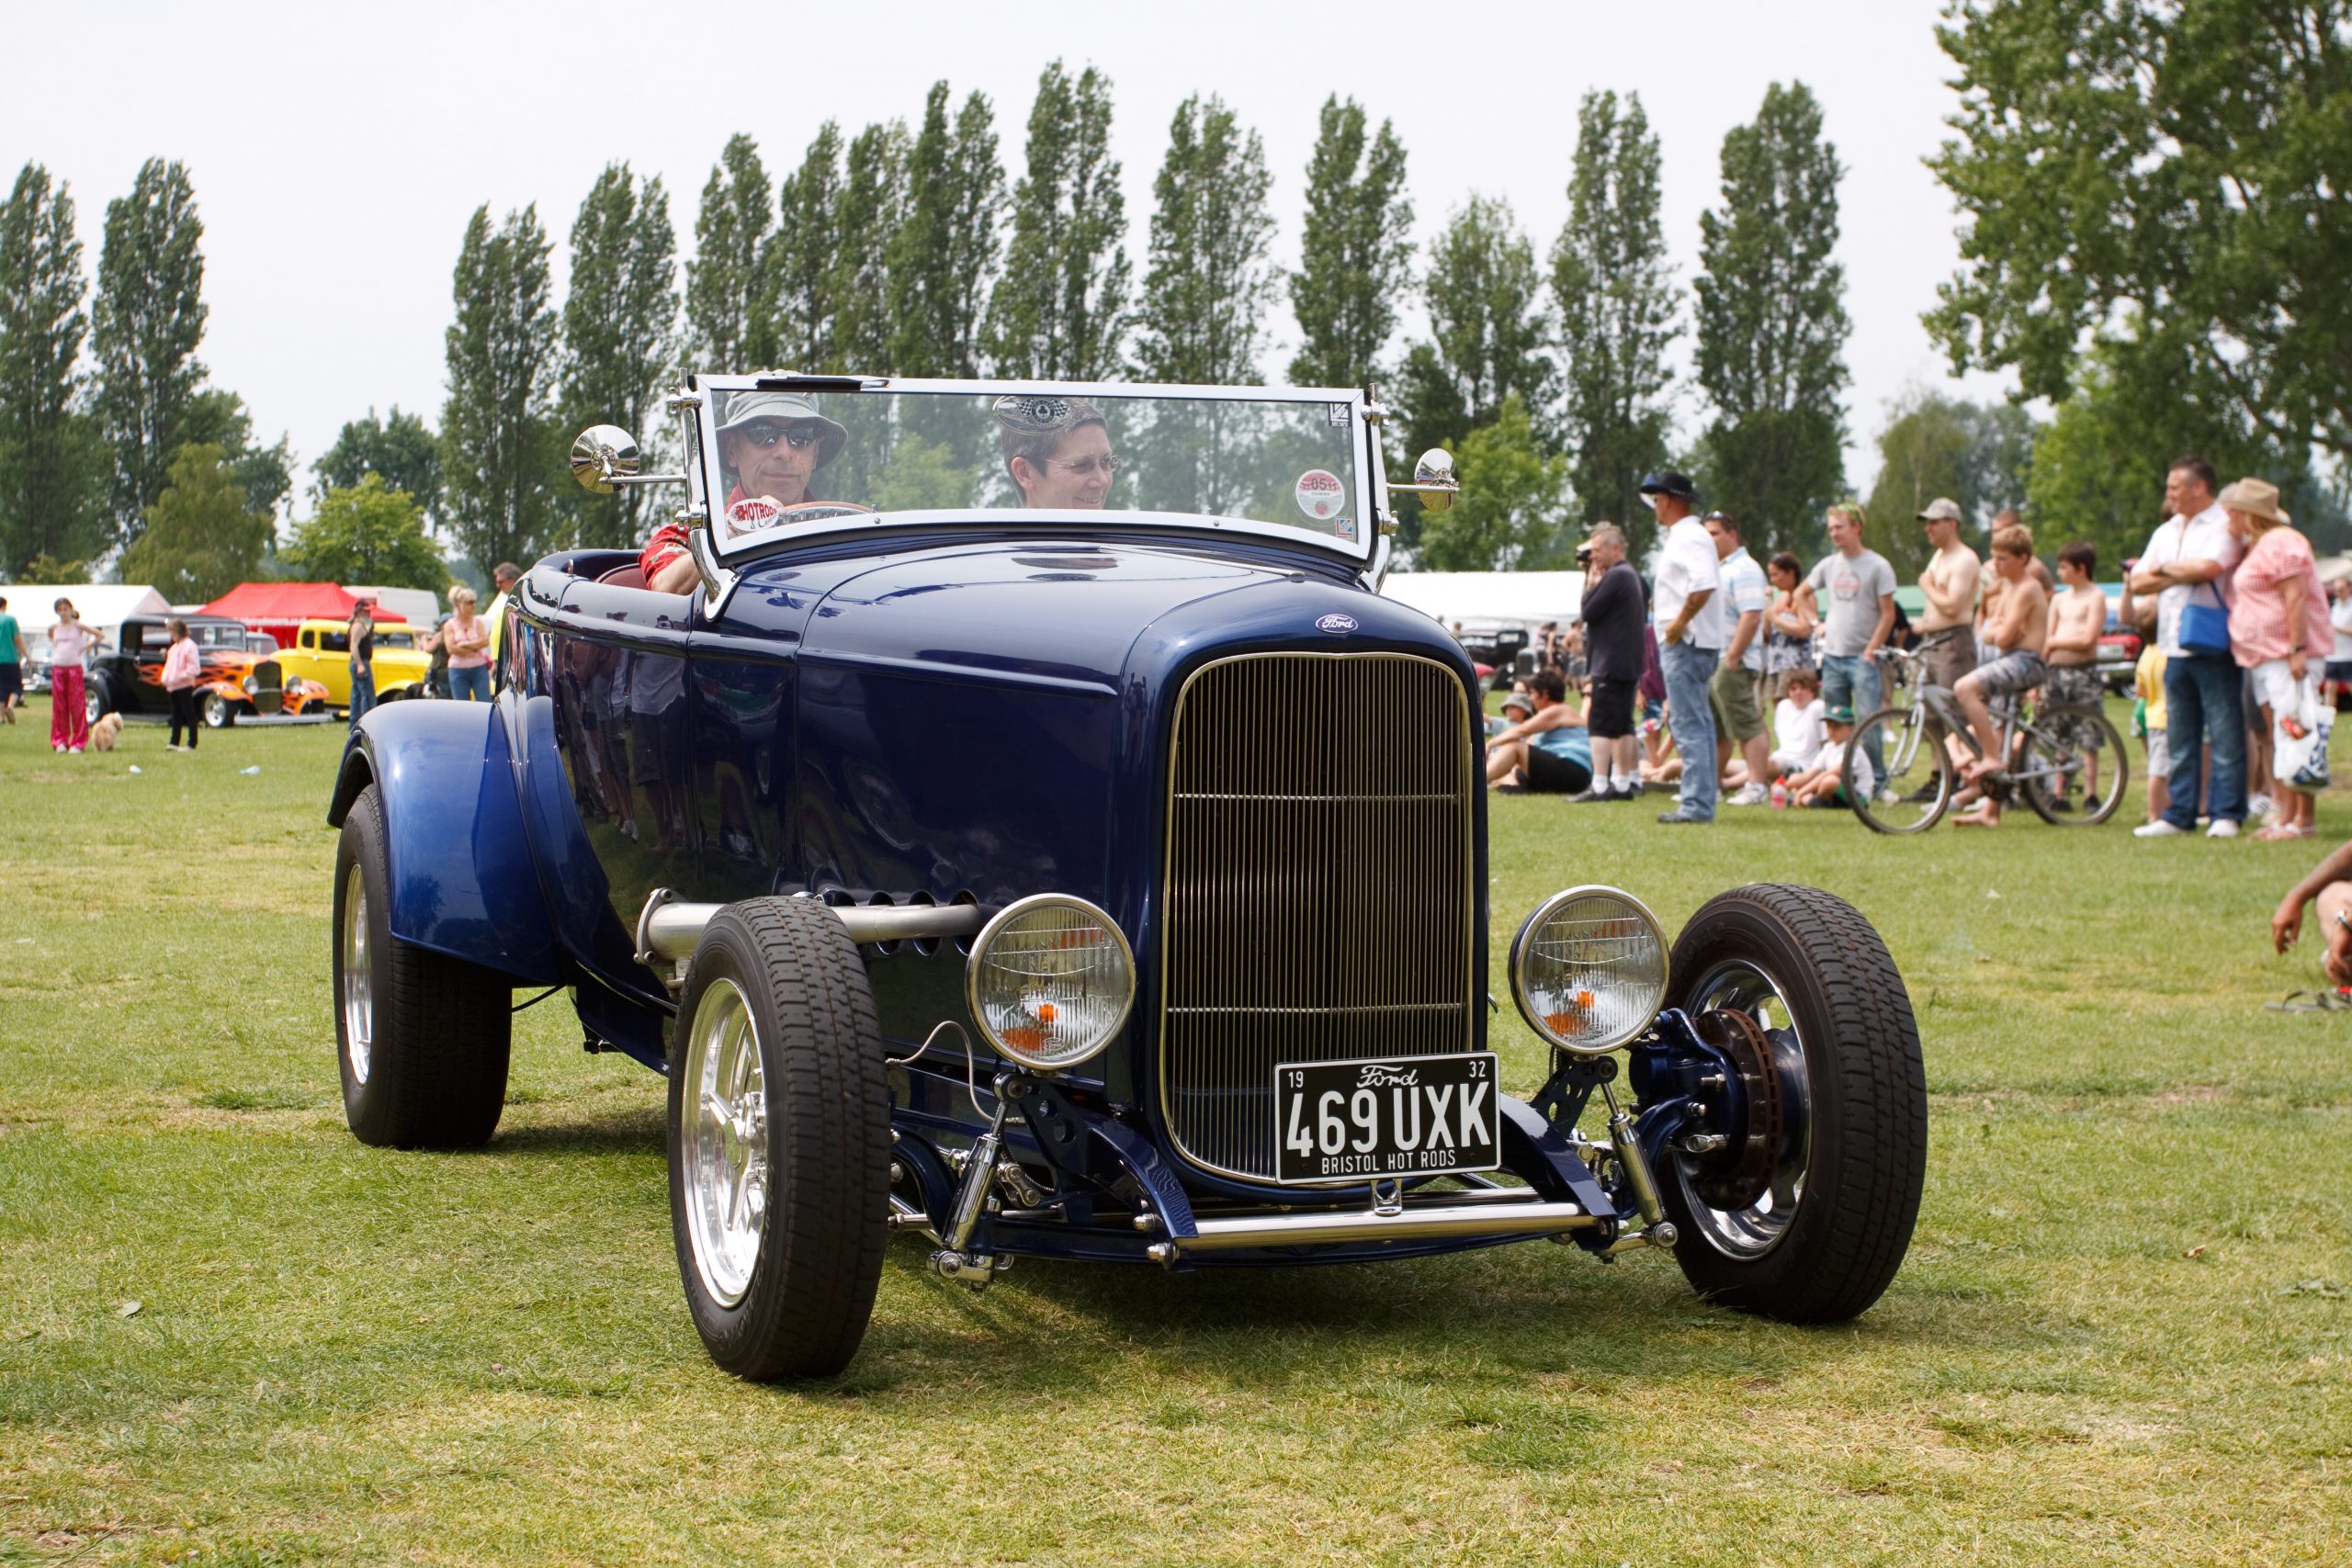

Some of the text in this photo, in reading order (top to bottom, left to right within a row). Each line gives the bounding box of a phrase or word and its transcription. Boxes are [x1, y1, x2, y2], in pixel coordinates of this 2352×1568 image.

[1311, 478, 1327, 491] 05
[1321, 615, 1354, 628] Ford
[1356, 1065, 1419, 1089] Ford
[1469, 1061, 1487, 1077] 32
[1288, 1071, 1304, 1089] 19
[1286, 1081, 1491, 1157] 469 UXK
[1321, 1149, 1456, 1175] BRISTOL HOT RODS
